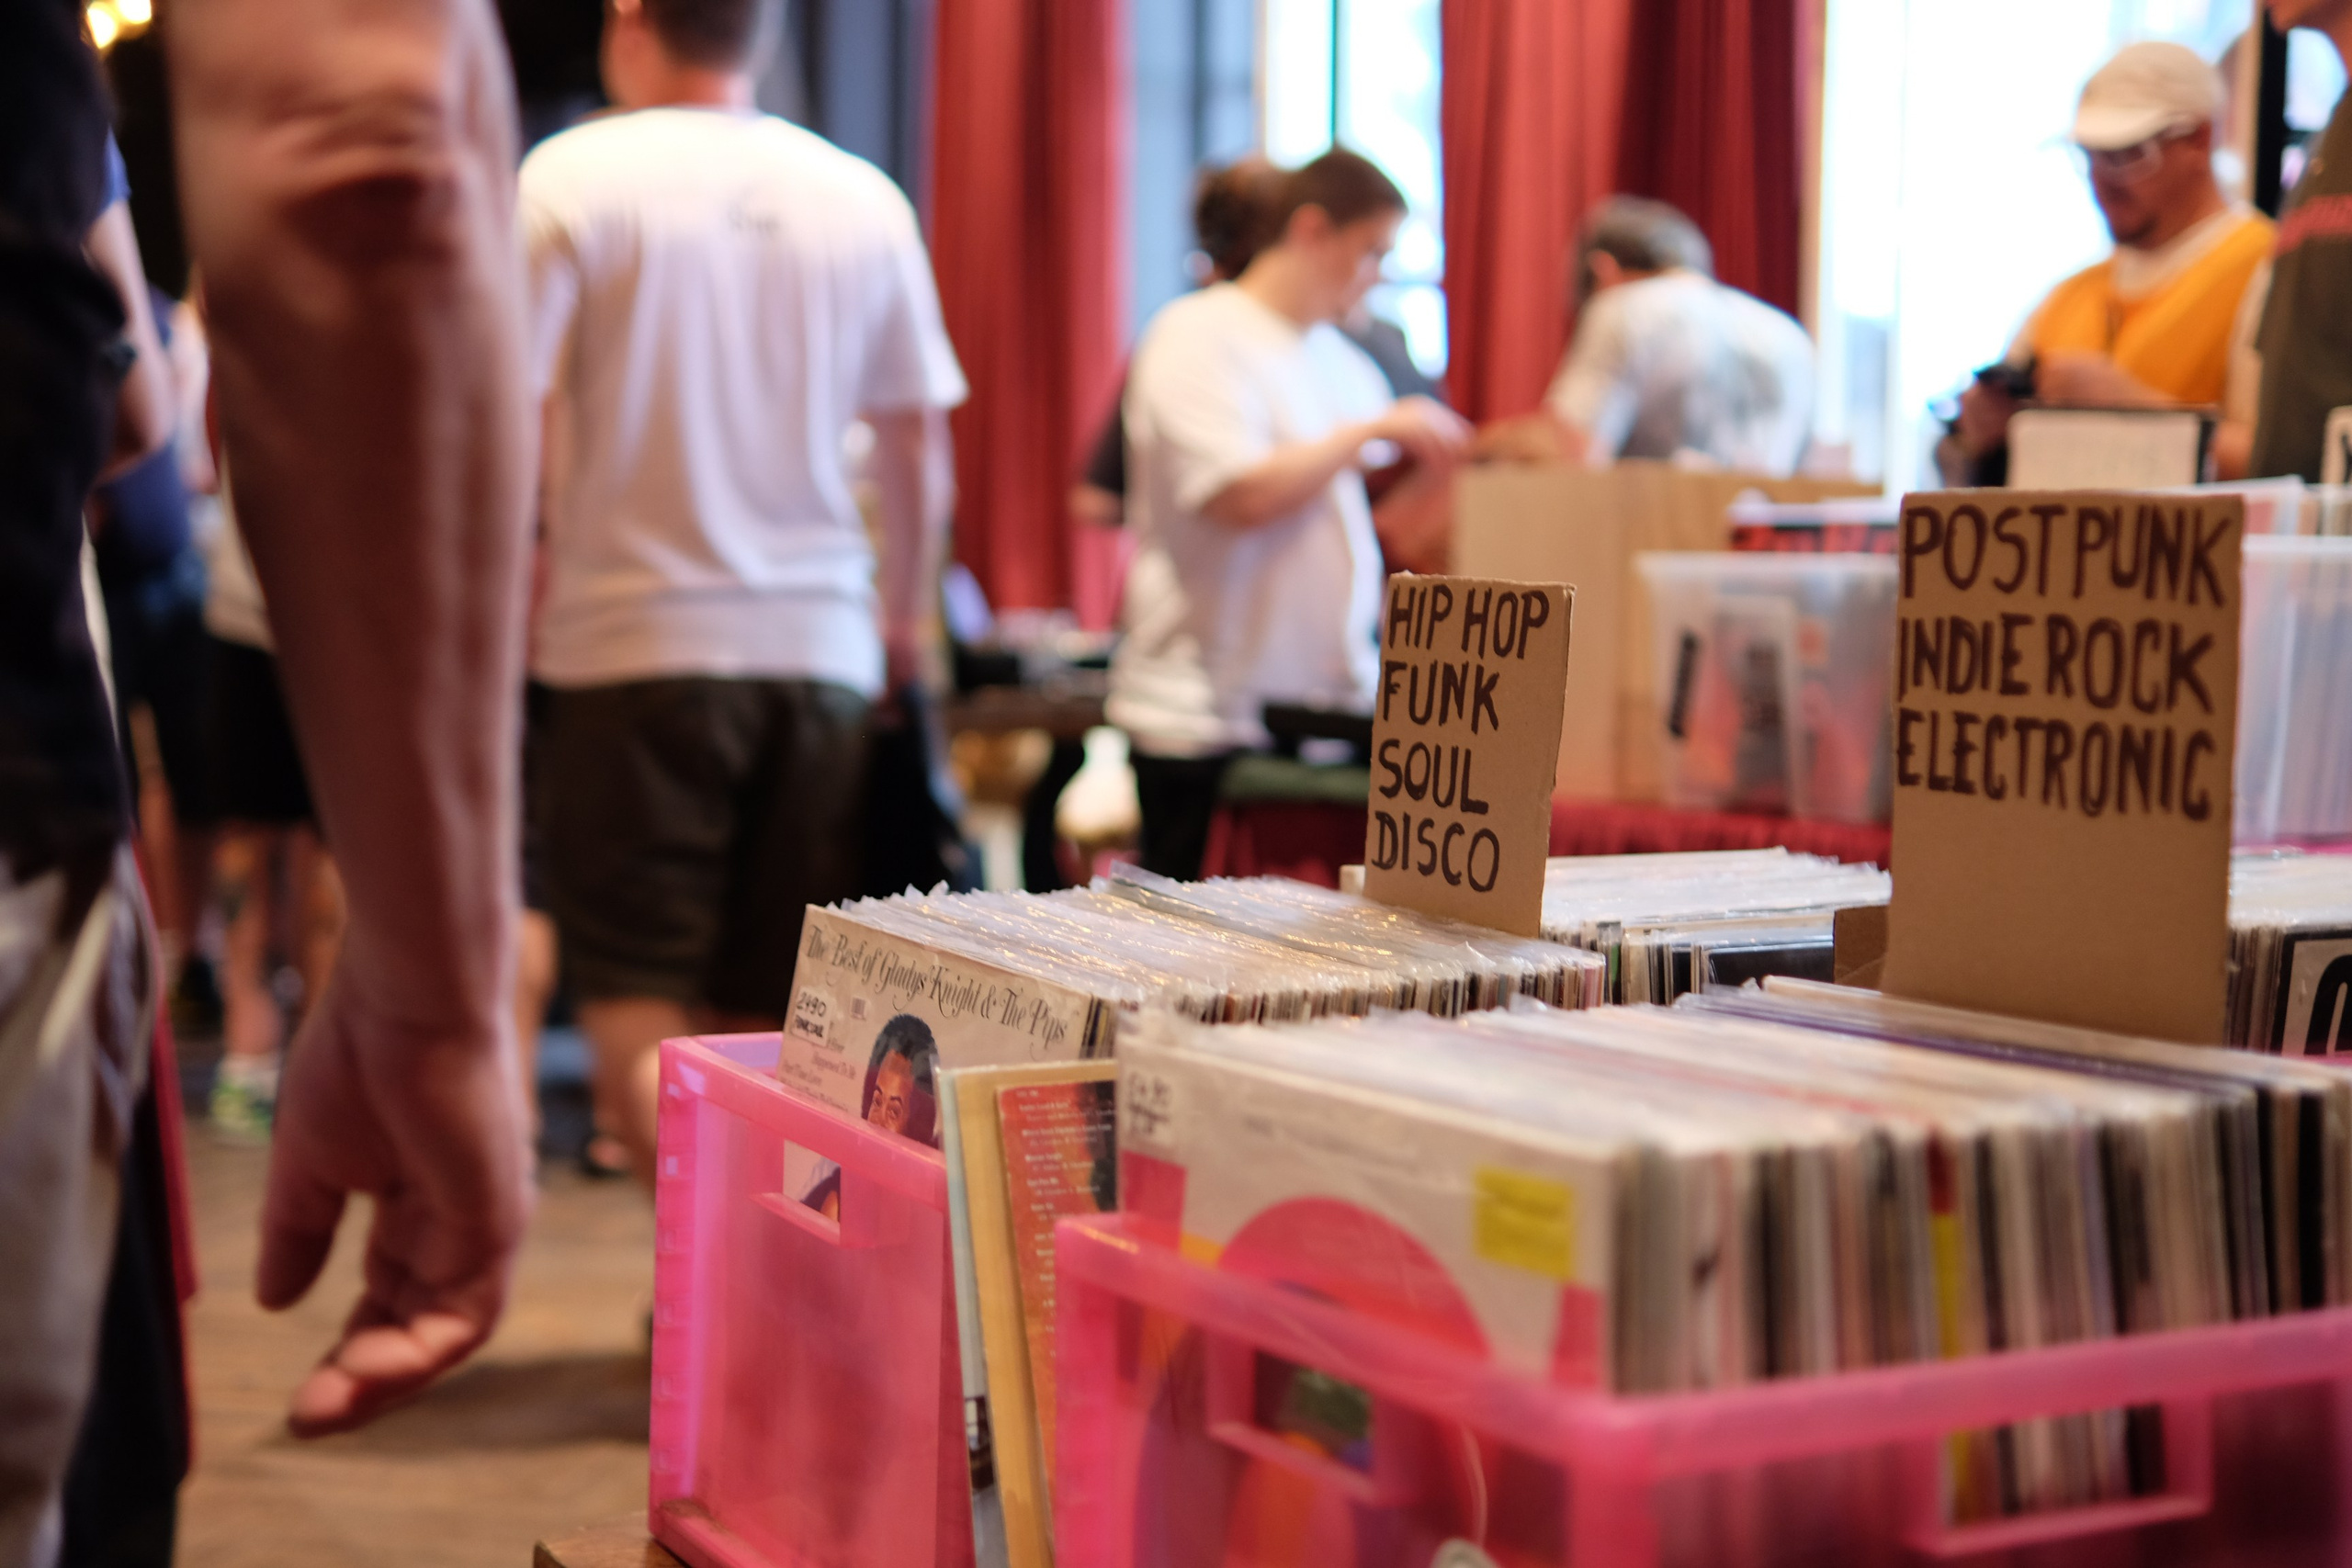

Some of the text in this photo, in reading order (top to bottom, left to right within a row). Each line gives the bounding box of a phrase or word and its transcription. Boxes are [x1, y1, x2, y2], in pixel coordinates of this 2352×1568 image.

[1904, 502, 2233, 608] POST PUNK
[1387, 583, 1550, 660] HIP HOP
[1897, 613, 2215, 715] INDIE ROCK
[1382, 660, 1500, 735] FUNK
[1378, 739, 1489, 815] SOUL
[1896, 706, 2216, 822] ELECTRONIC
[1371, 810, 1500, 893] DISCO
[807, 924, 1069, 1053] The Best of Gladys Knight & The Pips
